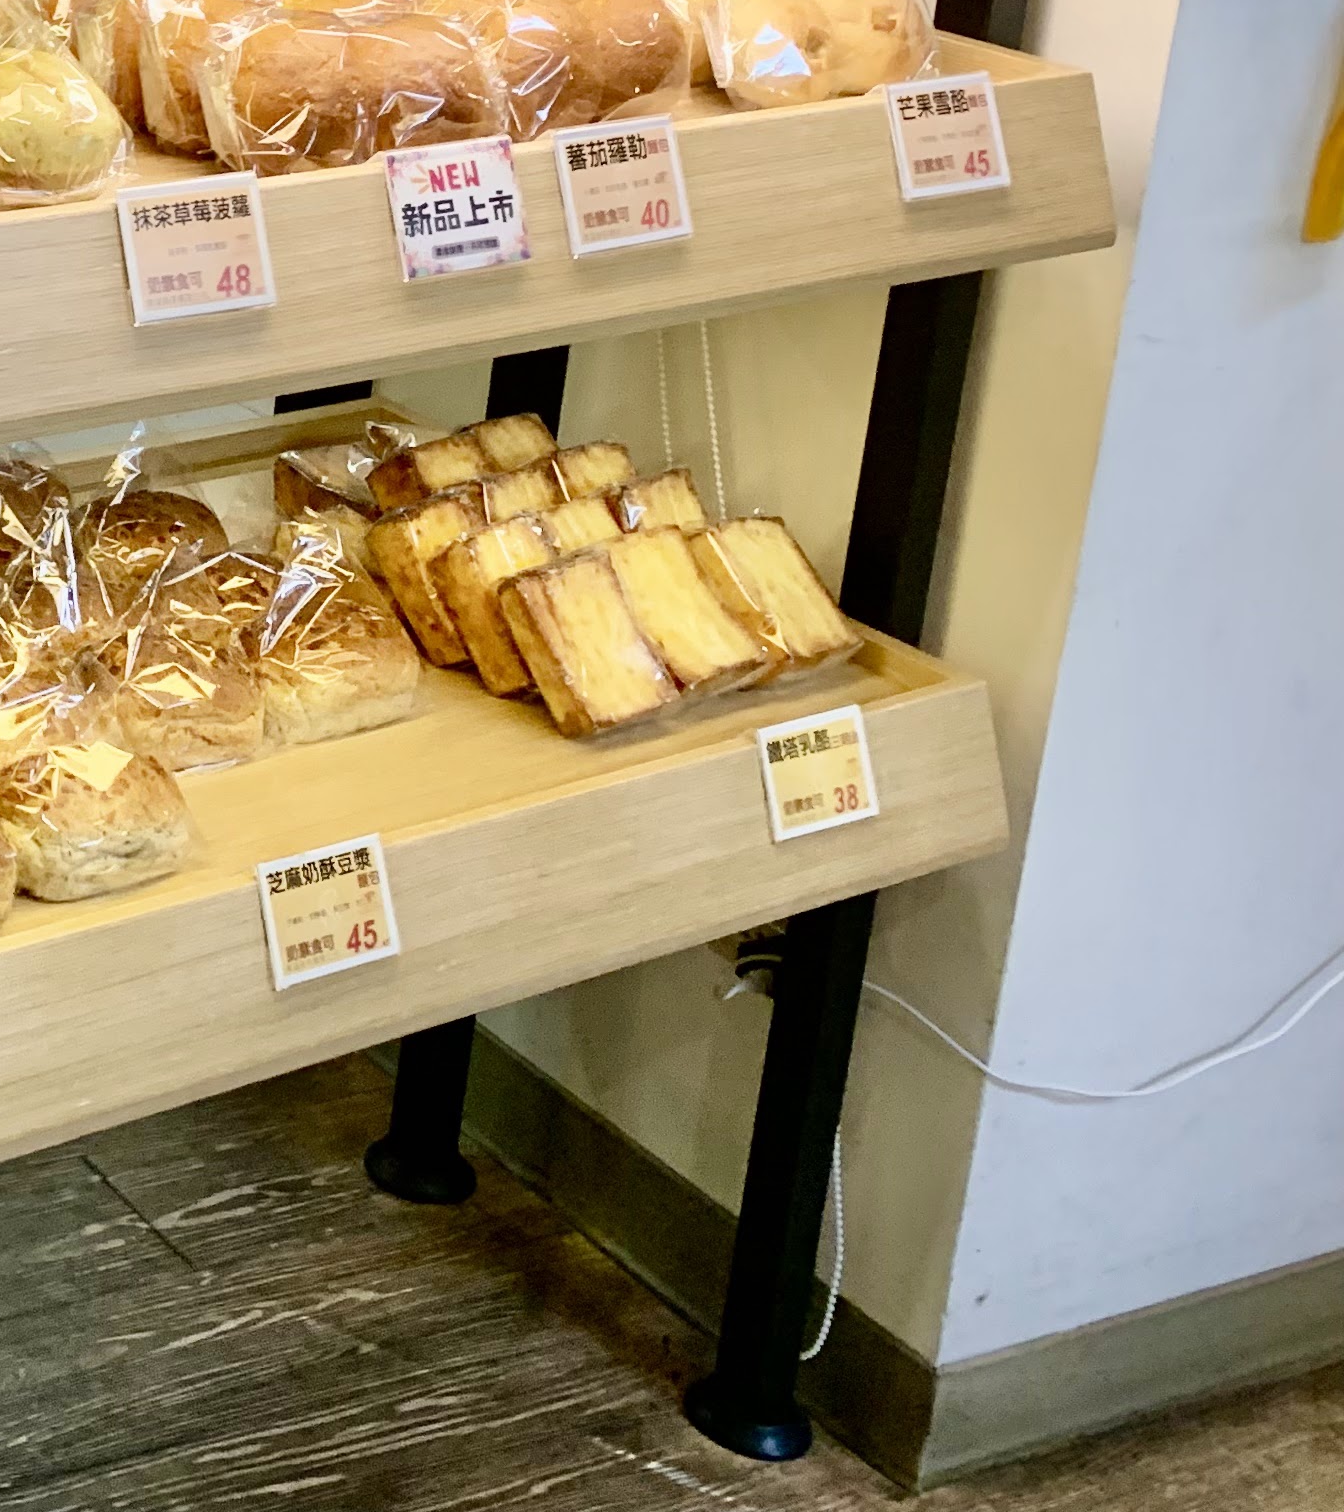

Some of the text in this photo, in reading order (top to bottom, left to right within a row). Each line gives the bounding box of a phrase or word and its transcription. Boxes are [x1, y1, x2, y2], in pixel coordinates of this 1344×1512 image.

[428, 160, 480, 193] NEW
[964, 149, 990, 177] 45
[132, 194, 251, 232] 抹茶草莓菠蘿
[401, 189, 514, 238] 新品上市
[641, 198, 669, 229] 40
[216, 264, 251, 297] 48
[834, 783, 859, 813] 38
[266, 847, 372, 895] 芝麻奶酥豆漿
[347, 919, 378, 953] 45
